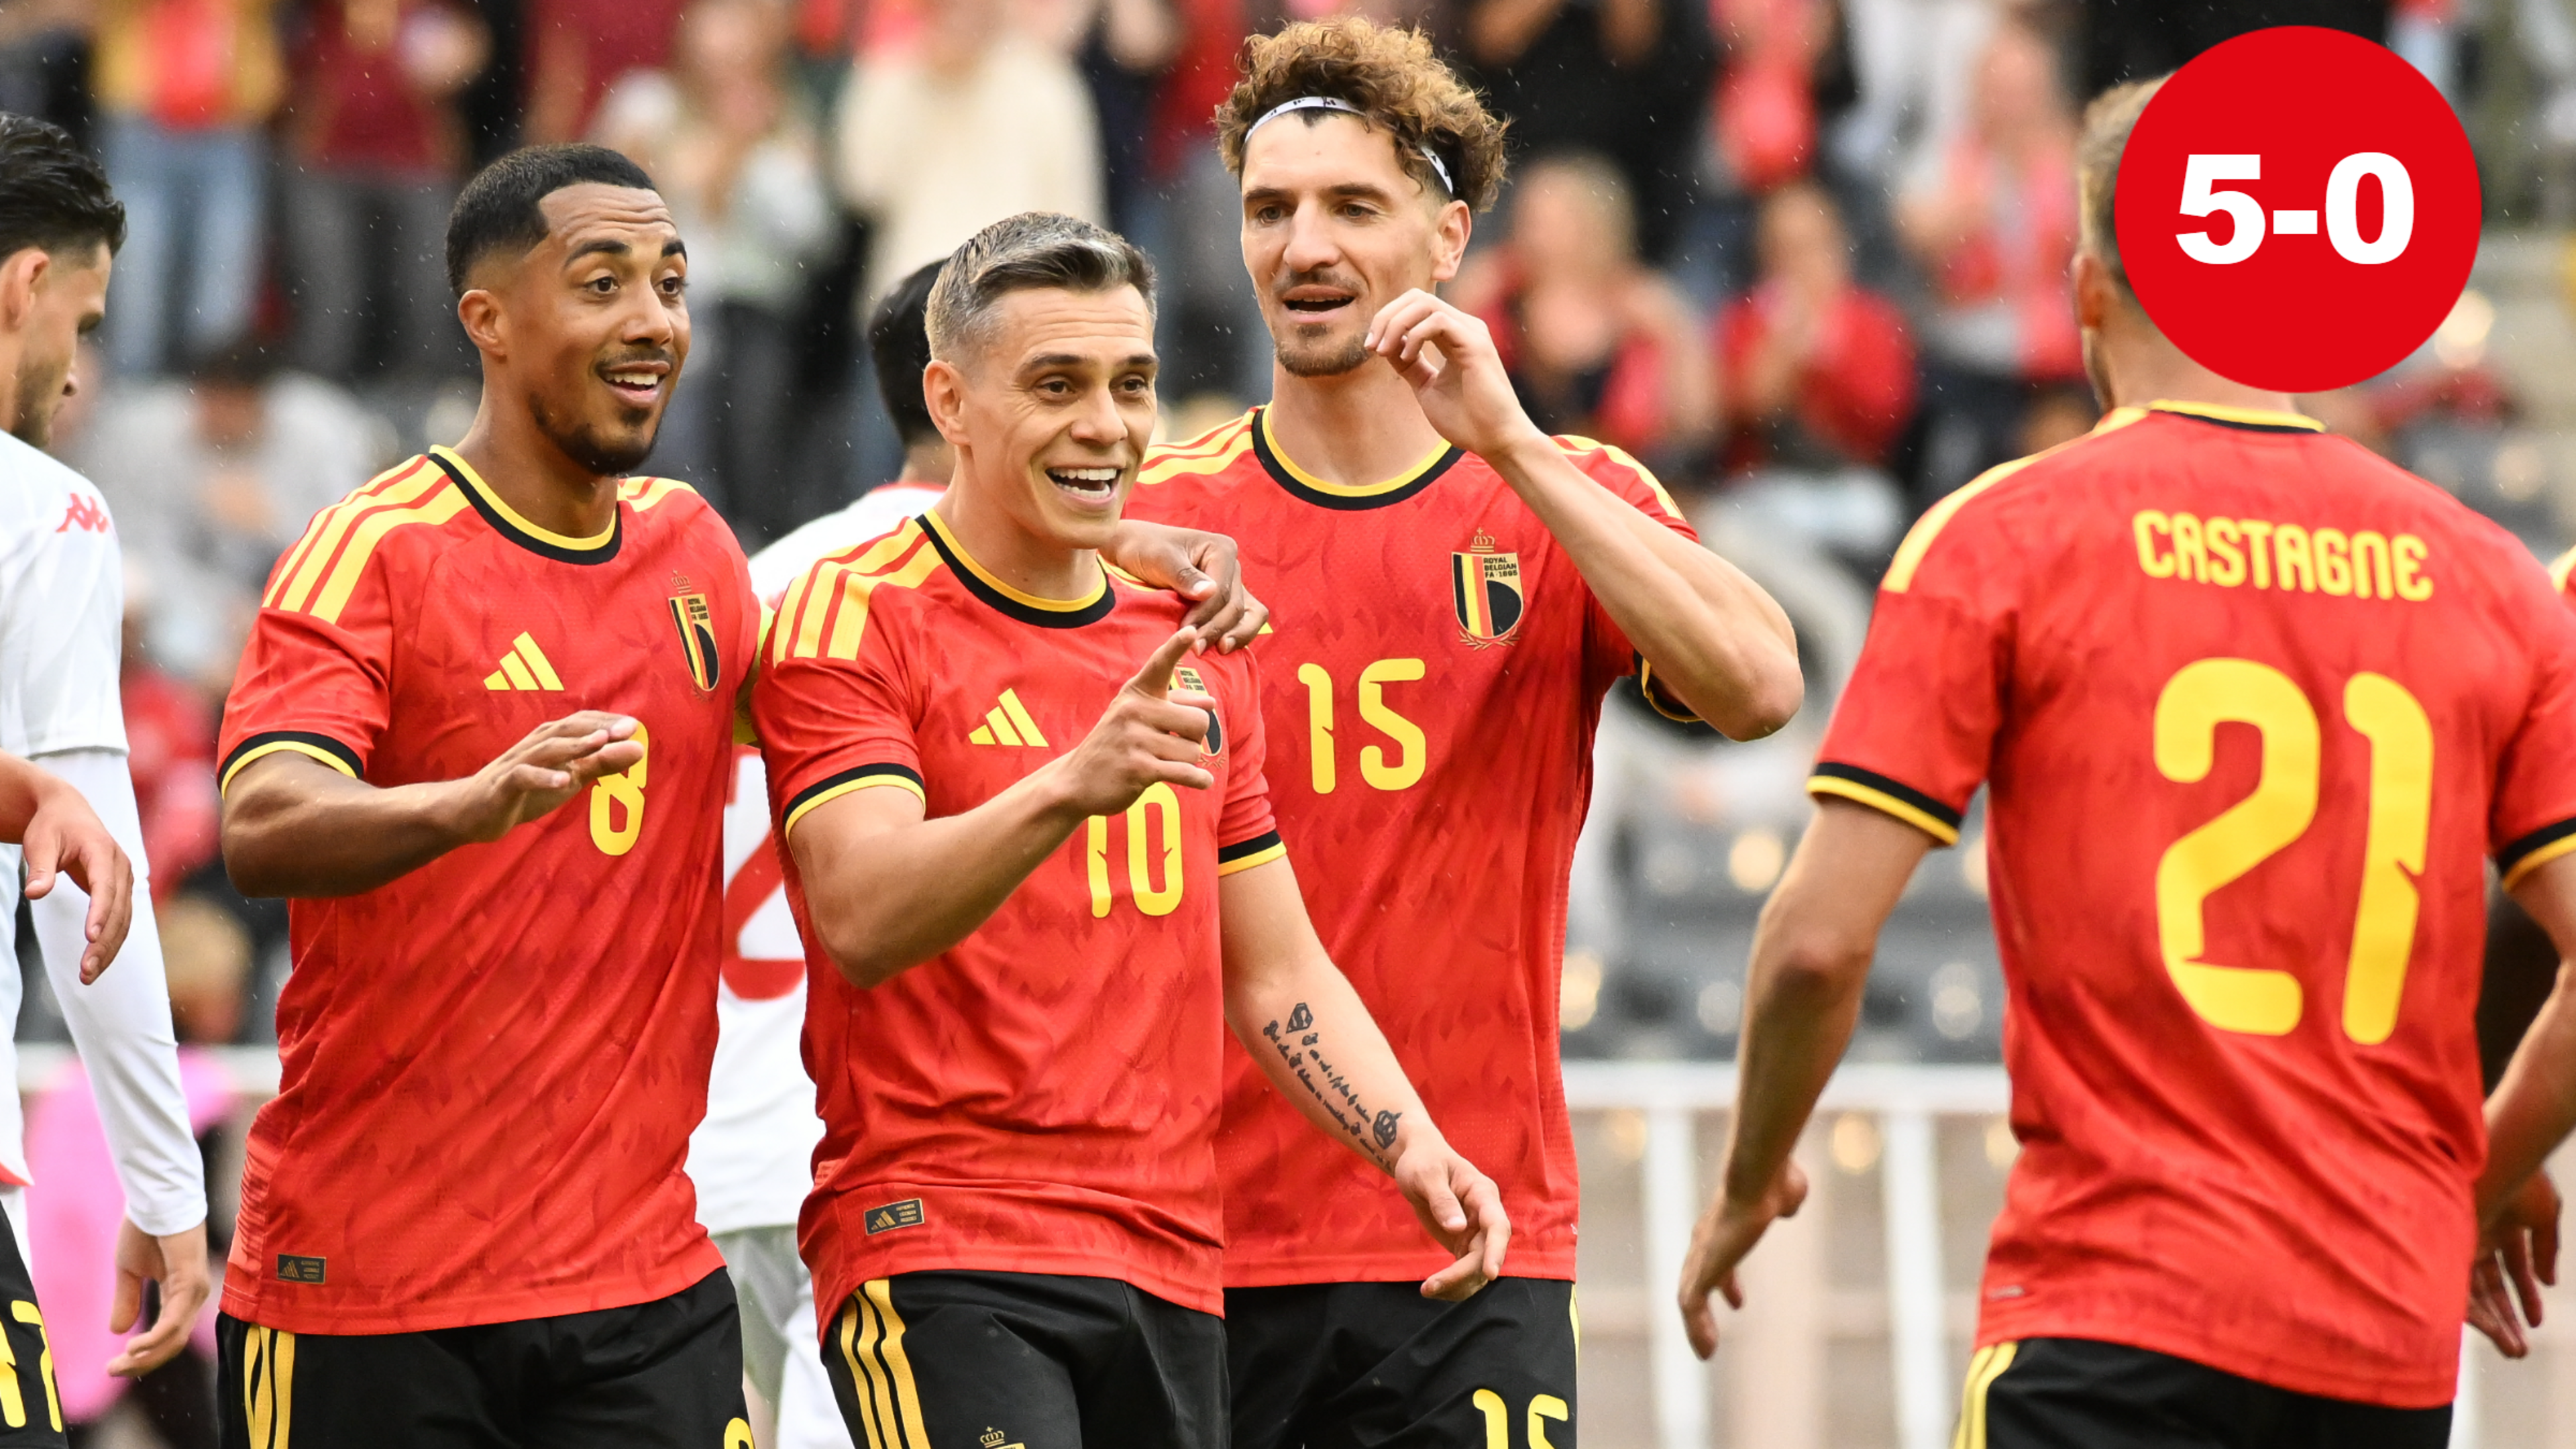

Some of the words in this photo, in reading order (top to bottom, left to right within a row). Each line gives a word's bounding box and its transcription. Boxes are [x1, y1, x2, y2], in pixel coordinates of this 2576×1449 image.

[1484, 563, 1517, 571] BELGIAN
[2133, 510, 2434, 602] CASTAGNE
[590, 720, 649, 856] 8
[1297, 658, 1426, 794] 15
[1087, 781, 1184, 918] 10
[2154, 657, 2434, 1044] 21
